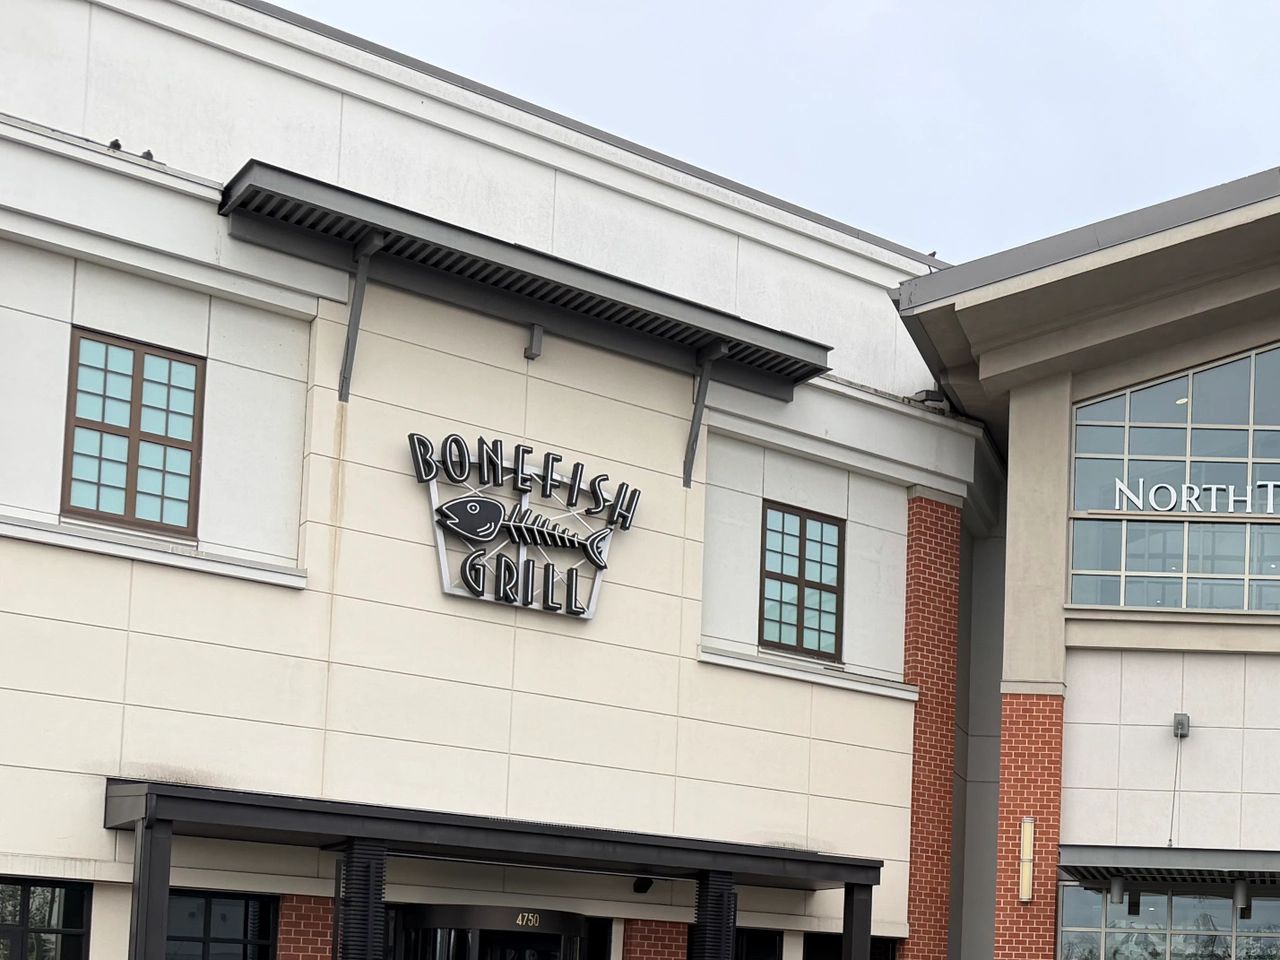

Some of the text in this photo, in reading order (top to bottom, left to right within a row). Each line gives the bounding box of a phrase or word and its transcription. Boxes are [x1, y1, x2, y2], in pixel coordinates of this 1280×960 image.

[408, 433, 641, 531] BONEFISH
[460, 548, 585, 616] GRILL
[516, 912, 540, 927] 4750
